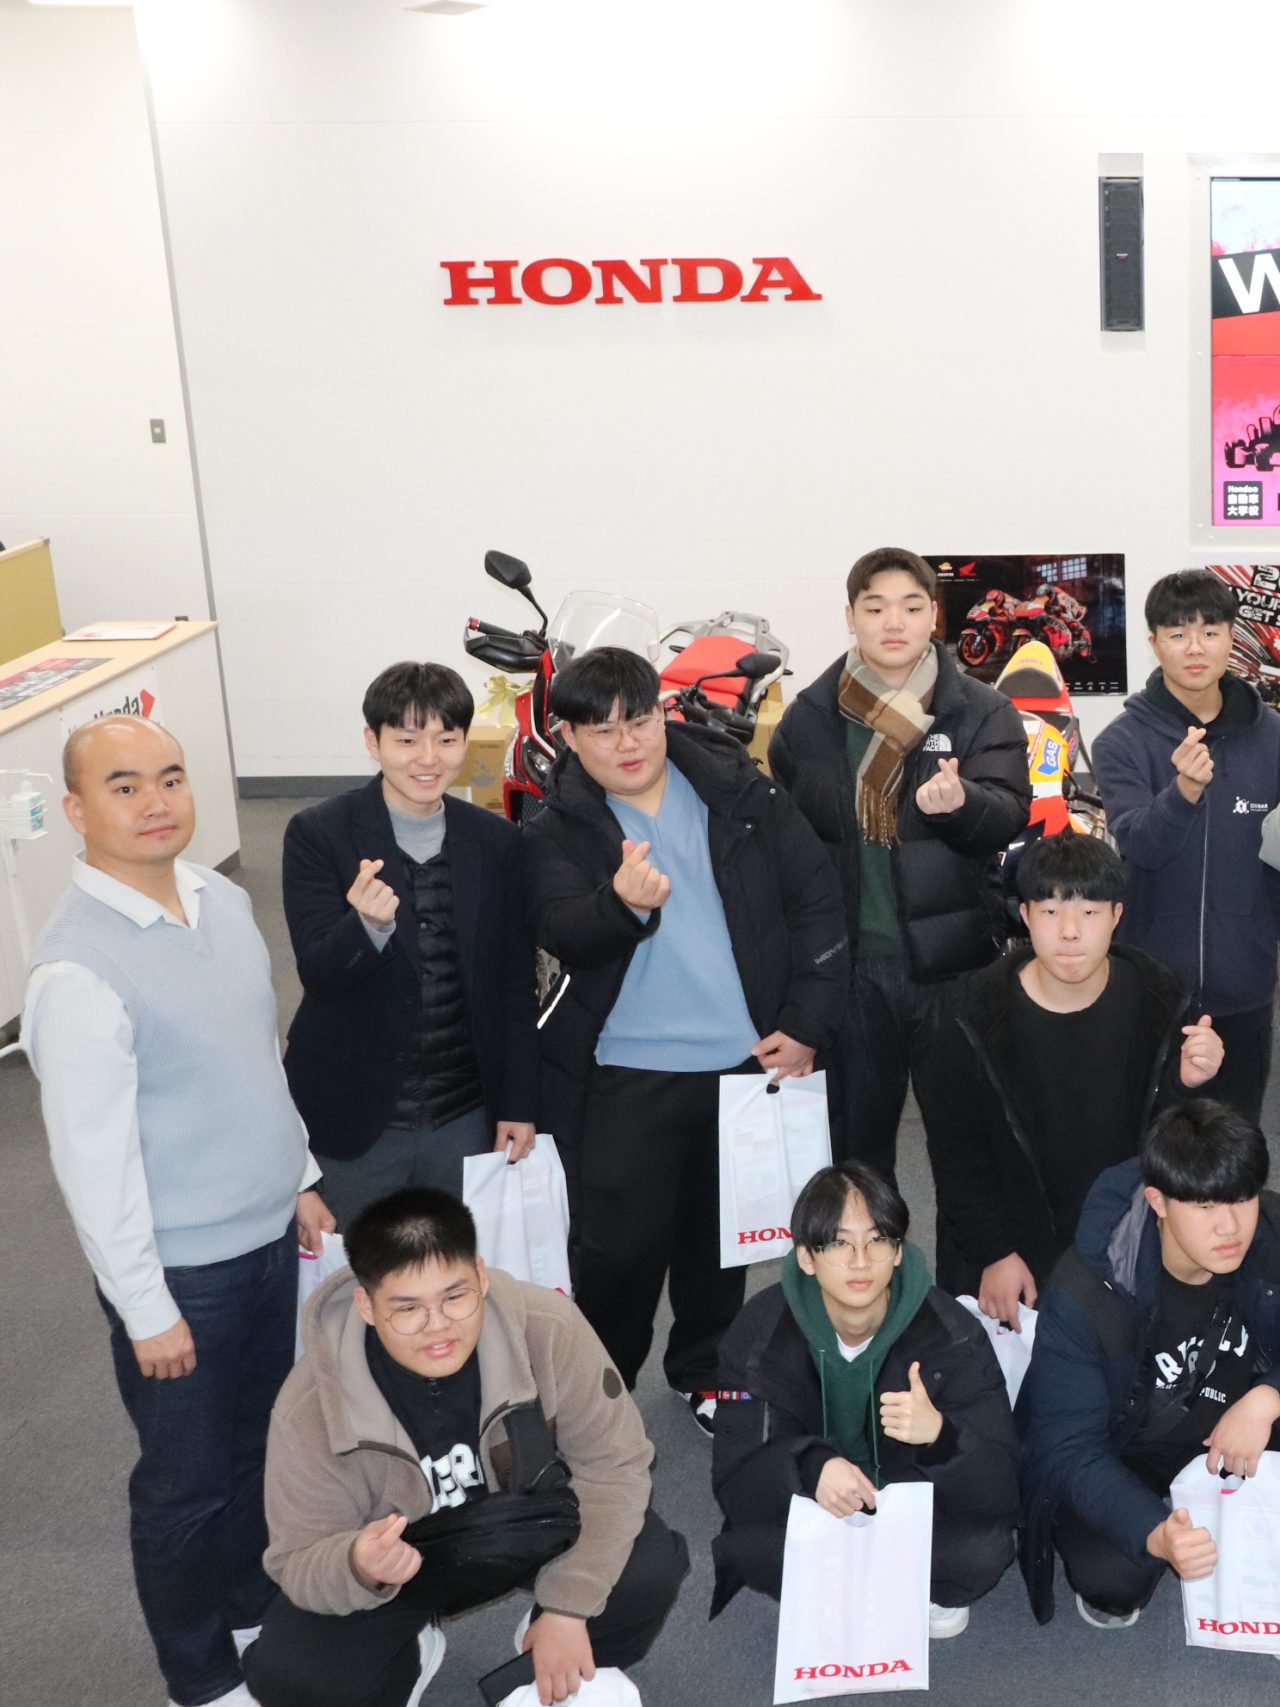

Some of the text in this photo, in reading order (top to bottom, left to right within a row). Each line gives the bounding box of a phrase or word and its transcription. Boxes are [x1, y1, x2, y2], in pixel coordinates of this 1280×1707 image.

[440, 256, 823, 306] HONDA
[1238, 604, 1275, 624] GET
[1046, 739, 1060, 769] GAS
[794, 1658, 914, 1682] HONDA
